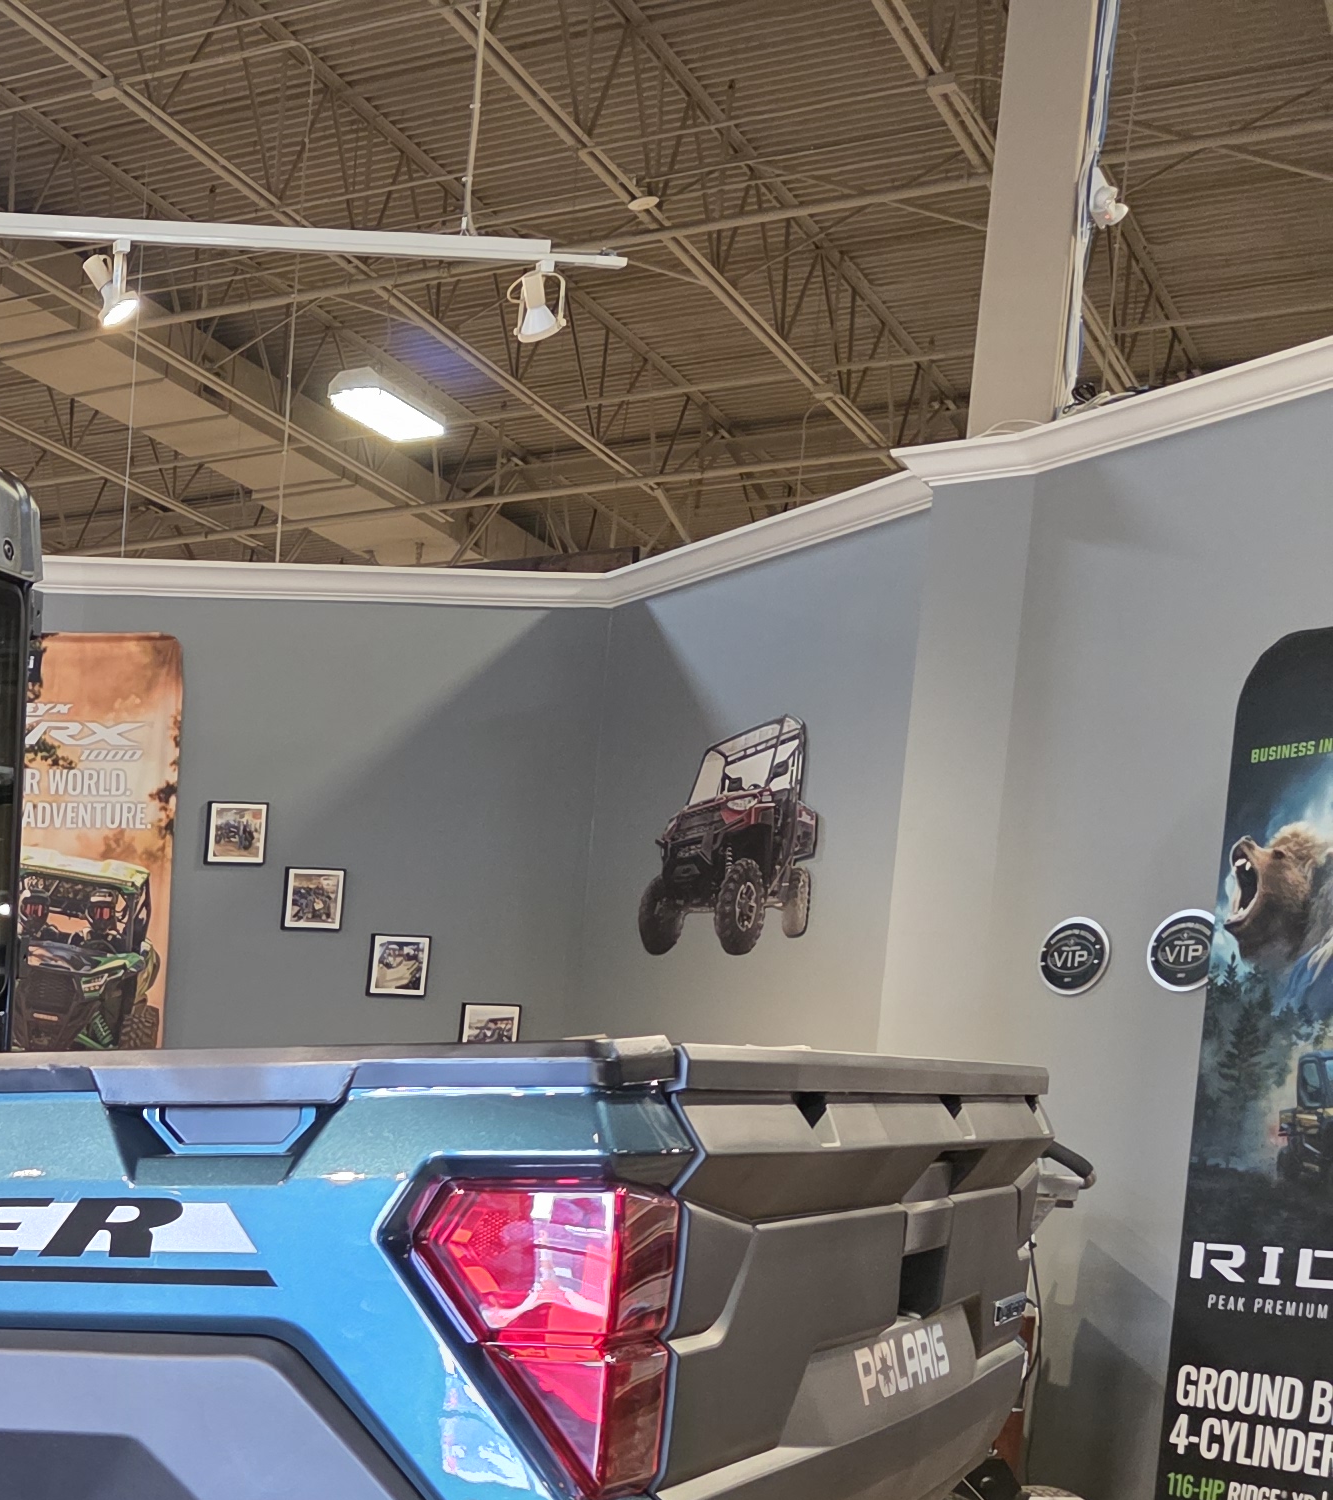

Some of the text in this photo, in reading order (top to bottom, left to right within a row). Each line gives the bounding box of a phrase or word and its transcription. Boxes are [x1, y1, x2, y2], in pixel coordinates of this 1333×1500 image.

[80, 749, 144, 761] 1000
[1251, 740, 1316, 763] BUSINESS
[49, 768, 133, 796] WORLD.
[23, 802, 152, 829] ADVENTURE.
[1053, 950, 1088, 968] VIP
[1165, 945, 1203, 963] VIP
[1207, 1293, 1329, 1320] PEAK PREMIUM
[854, 1324, 950, 1406] POLARIS
[1176, 1364, 1304, 1420] GROUND
